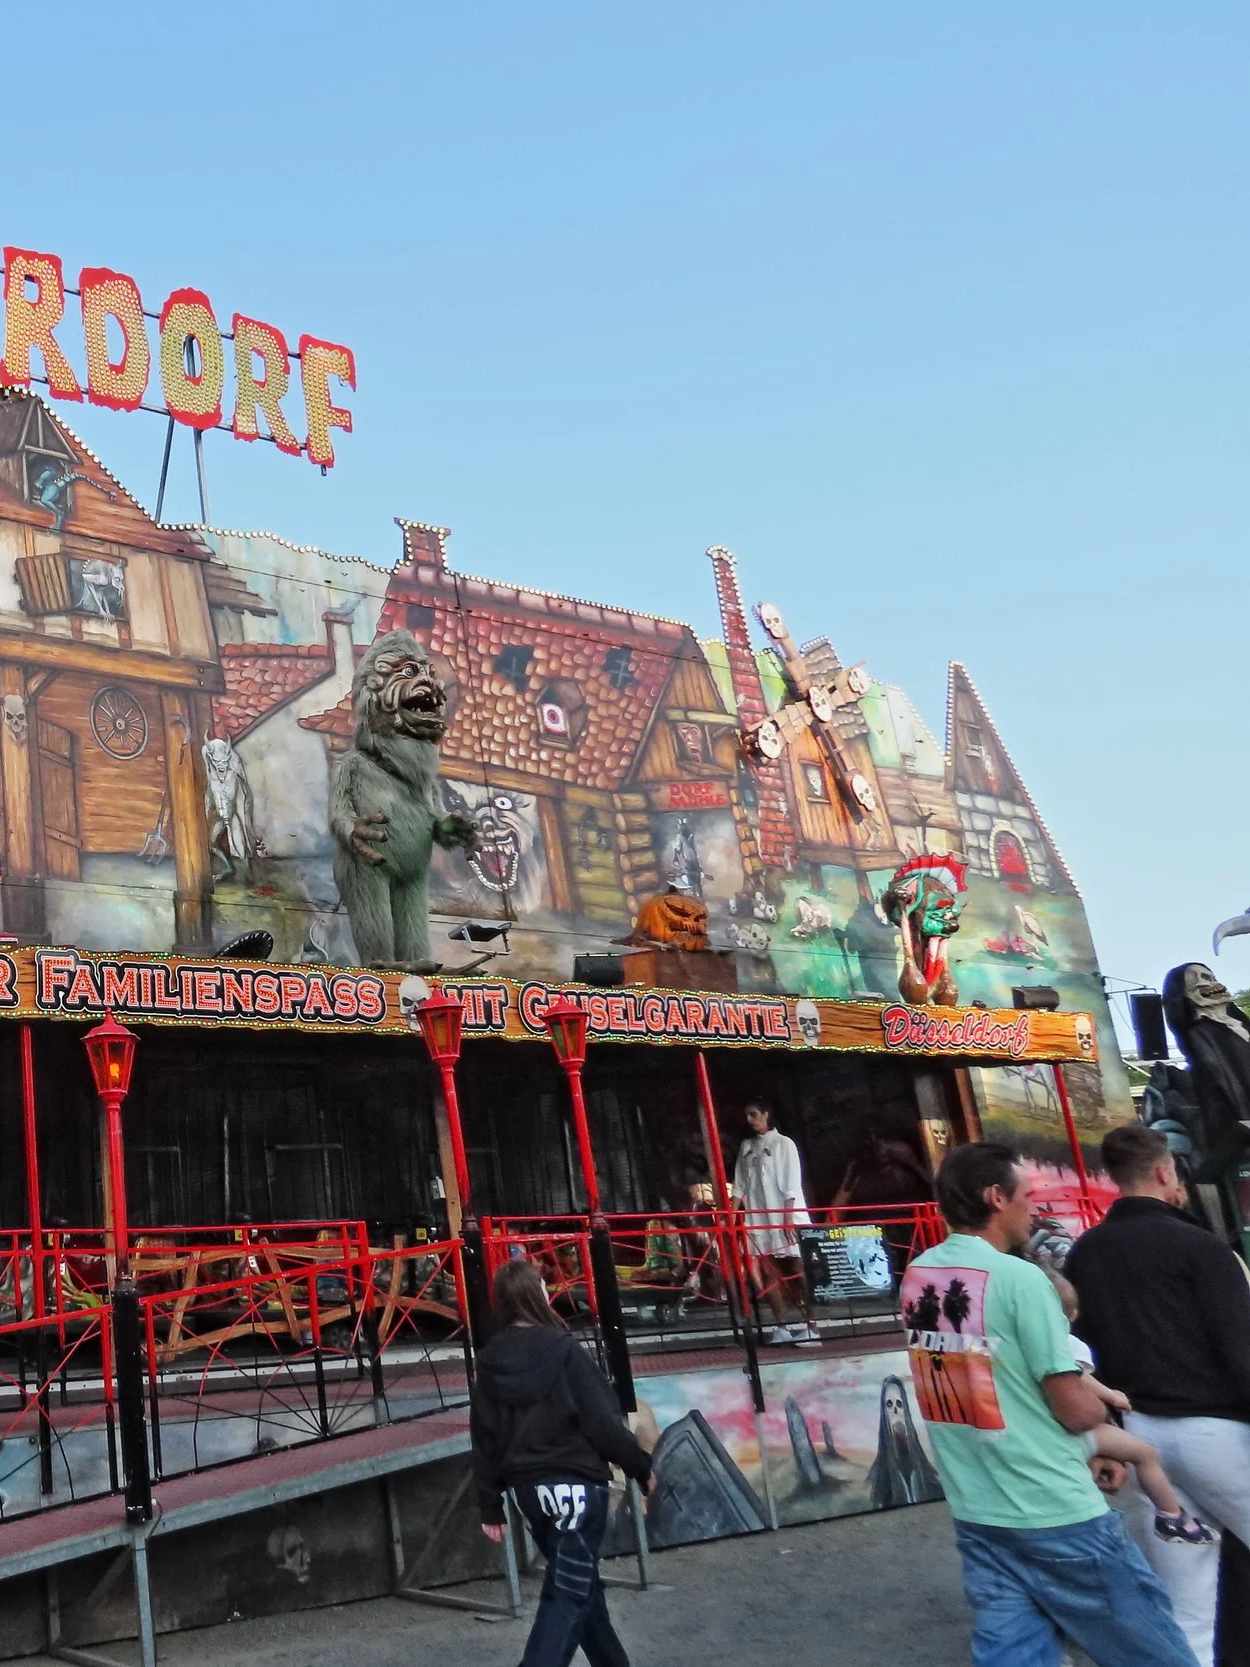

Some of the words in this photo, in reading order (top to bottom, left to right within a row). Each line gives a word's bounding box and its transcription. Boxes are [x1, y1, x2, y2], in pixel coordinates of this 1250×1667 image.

[669, 781, 715, 796] DORF
[38, 952, 387, 1018] FAMILIENSPASS
[445, 988, 506, 1026] MIT
[884, 1005, 1029, 1054] Düsseldorf
